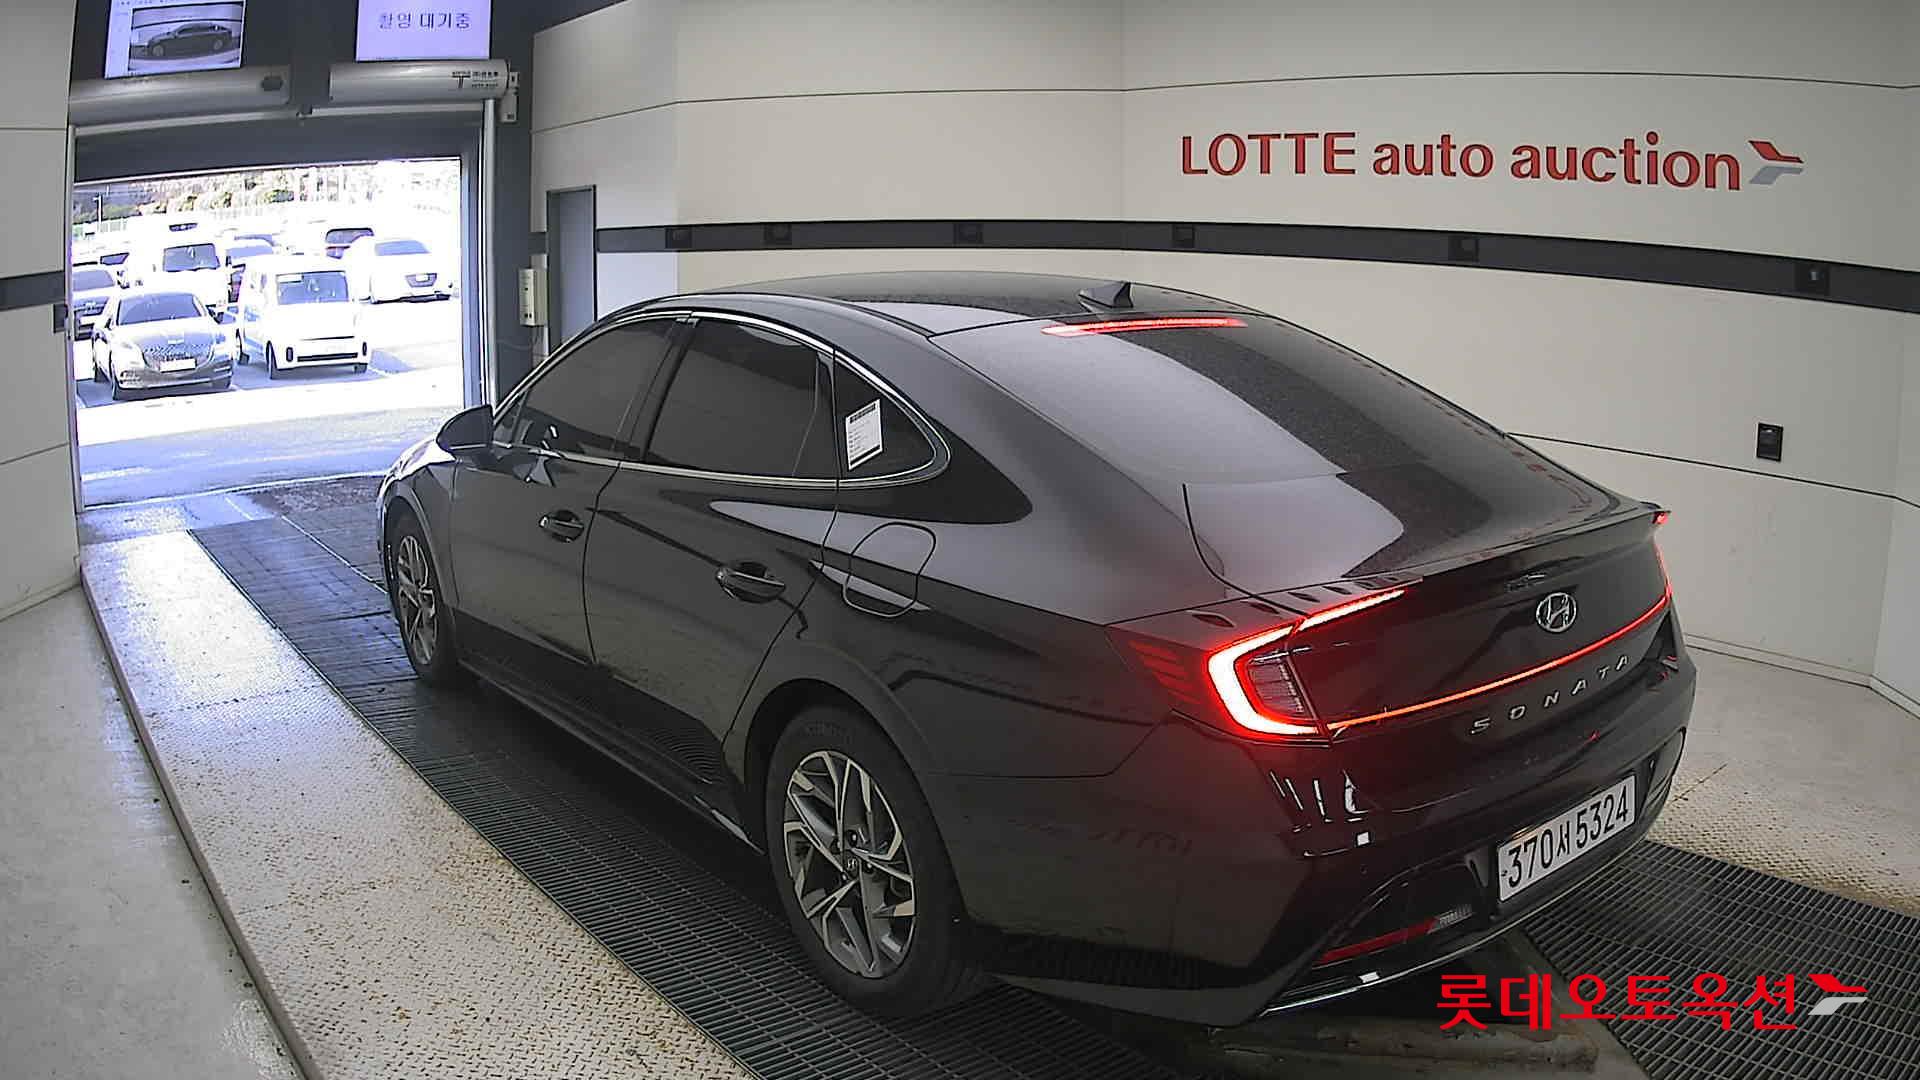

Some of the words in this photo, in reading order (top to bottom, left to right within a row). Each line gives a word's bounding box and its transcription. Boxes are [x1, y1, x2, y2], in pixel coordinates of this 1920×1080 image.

[420, 13, 470, 29] 대기중
[1182, 132, 1356, 177] LOTTE
[1373, 134, 1494, 178] auto
[1511, 132, 1742, 191] auction
[1470, 655, 1629, 735] SONATA
